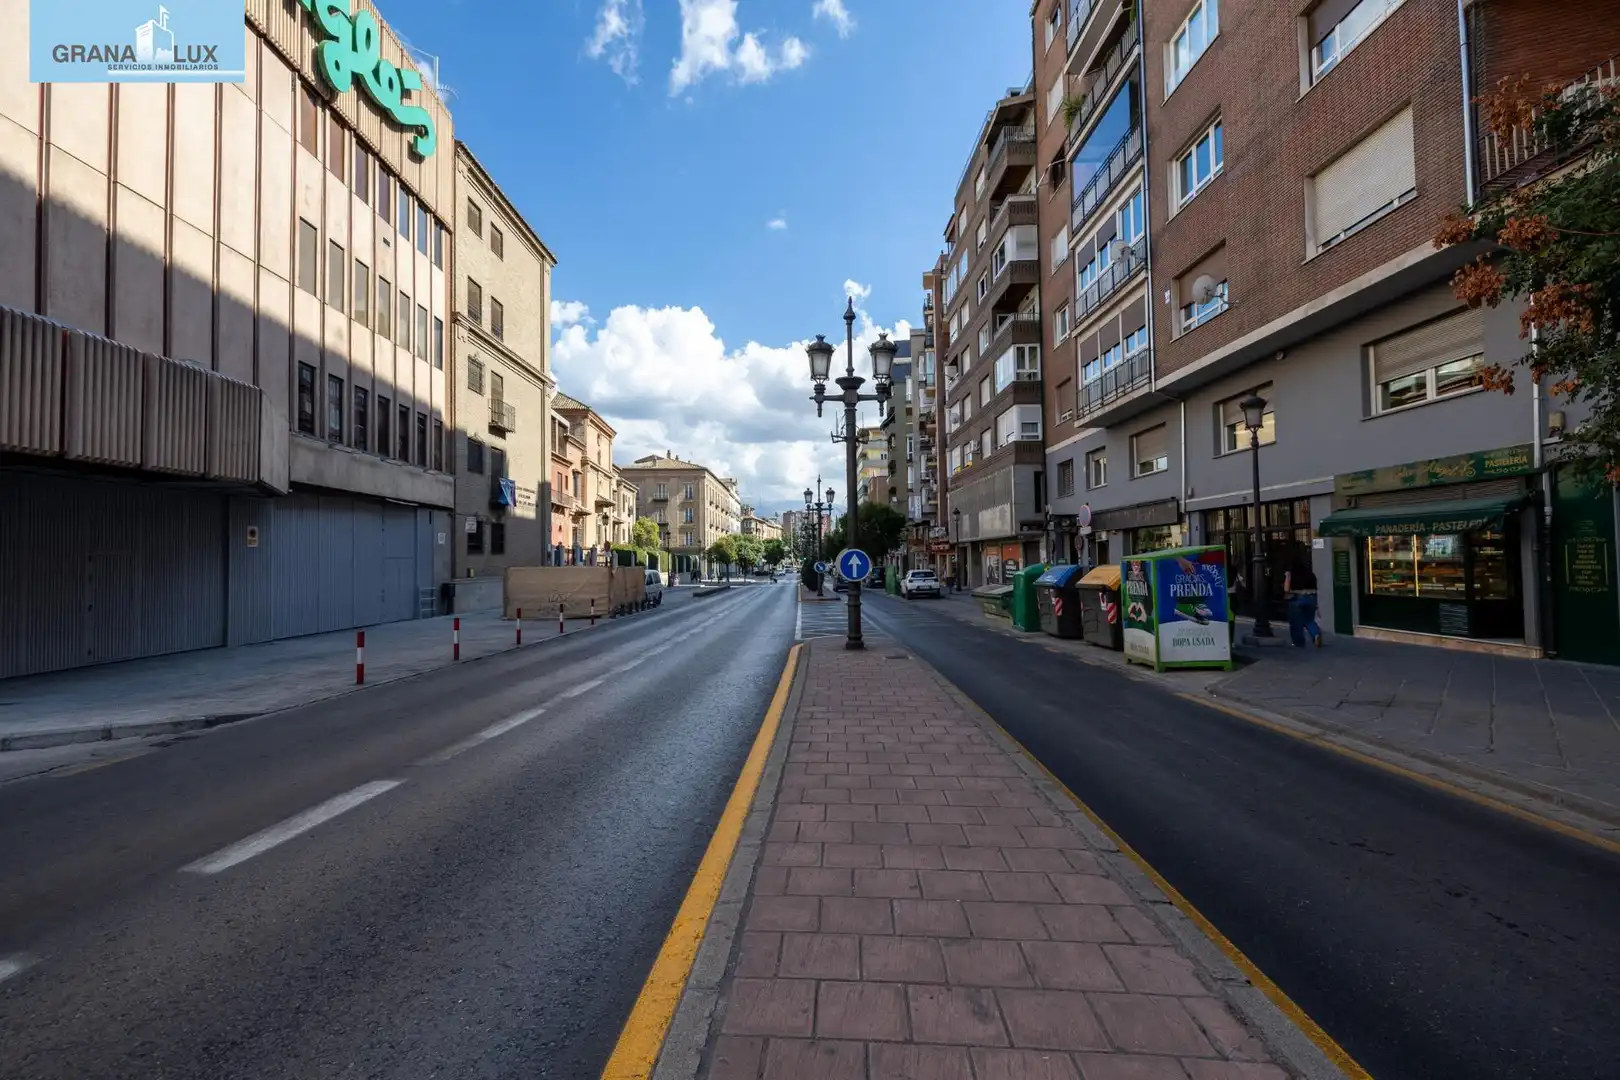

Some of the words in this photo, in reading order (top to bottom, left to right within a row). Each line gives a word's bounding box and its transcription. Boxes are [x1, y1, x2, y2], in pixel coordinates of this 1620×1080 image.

[1375, 521, 1425, 534] PANADERÍA
[1170, 583, 1213, 597] PRENDA
[1192, 637, 1216, 646] USADA
